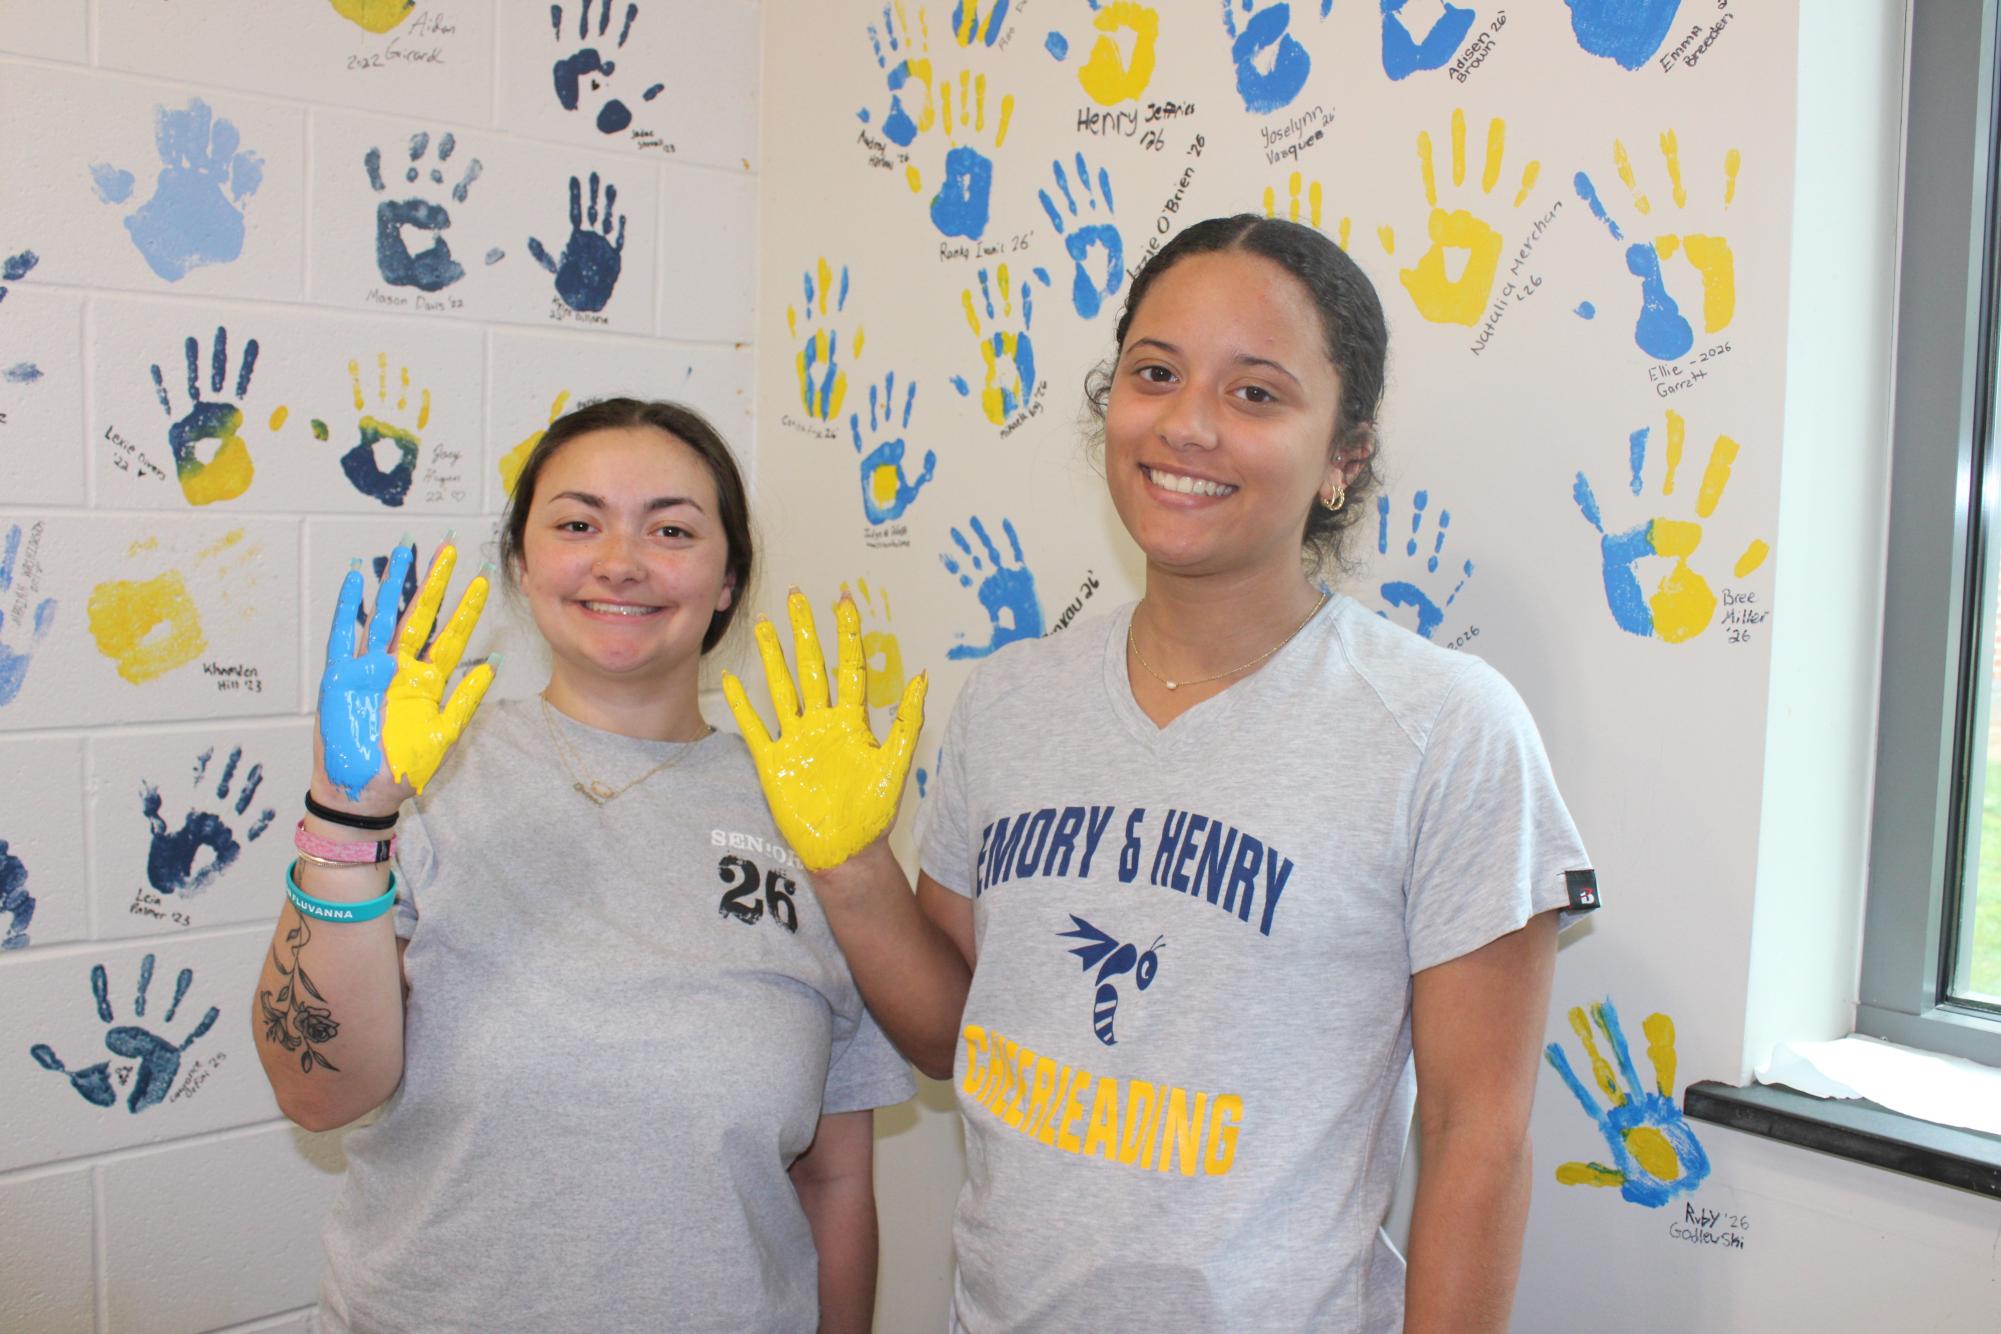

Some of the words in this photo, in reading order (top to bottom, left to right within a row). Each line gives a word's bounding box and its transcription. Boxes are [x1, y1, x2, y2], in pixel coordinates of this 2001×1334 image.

[1449, 32, 1490, 80] Adisen
[1077, 107, 1138, 137] Henry
[1261, 105, 1323, 149] Yoselynn
[1157, 167, 1195, 234] O'Brien
[366, 288, 408, 305] Mason
[1470, 282, 1516, 357] Natalia
[1510, 201, 1563, 276] Merchan
[1648, 363, 1683, 382] Ellie
[105, 425, 135, 455] Lexie
[1721, 588, 1757, 606] Bree
[1721, 608, 1769, 625] Miller
[976, 806, 1115, 899] EMORY
[1118, 808, 1145, 883] &
[1151, 809, 1294, 936] HENRY
[718, 855, 798, 934] 26
[963, 1025, 1243, 1177] CHEERLEADING
[1686, 1201, 1720, 1228] Ruby
